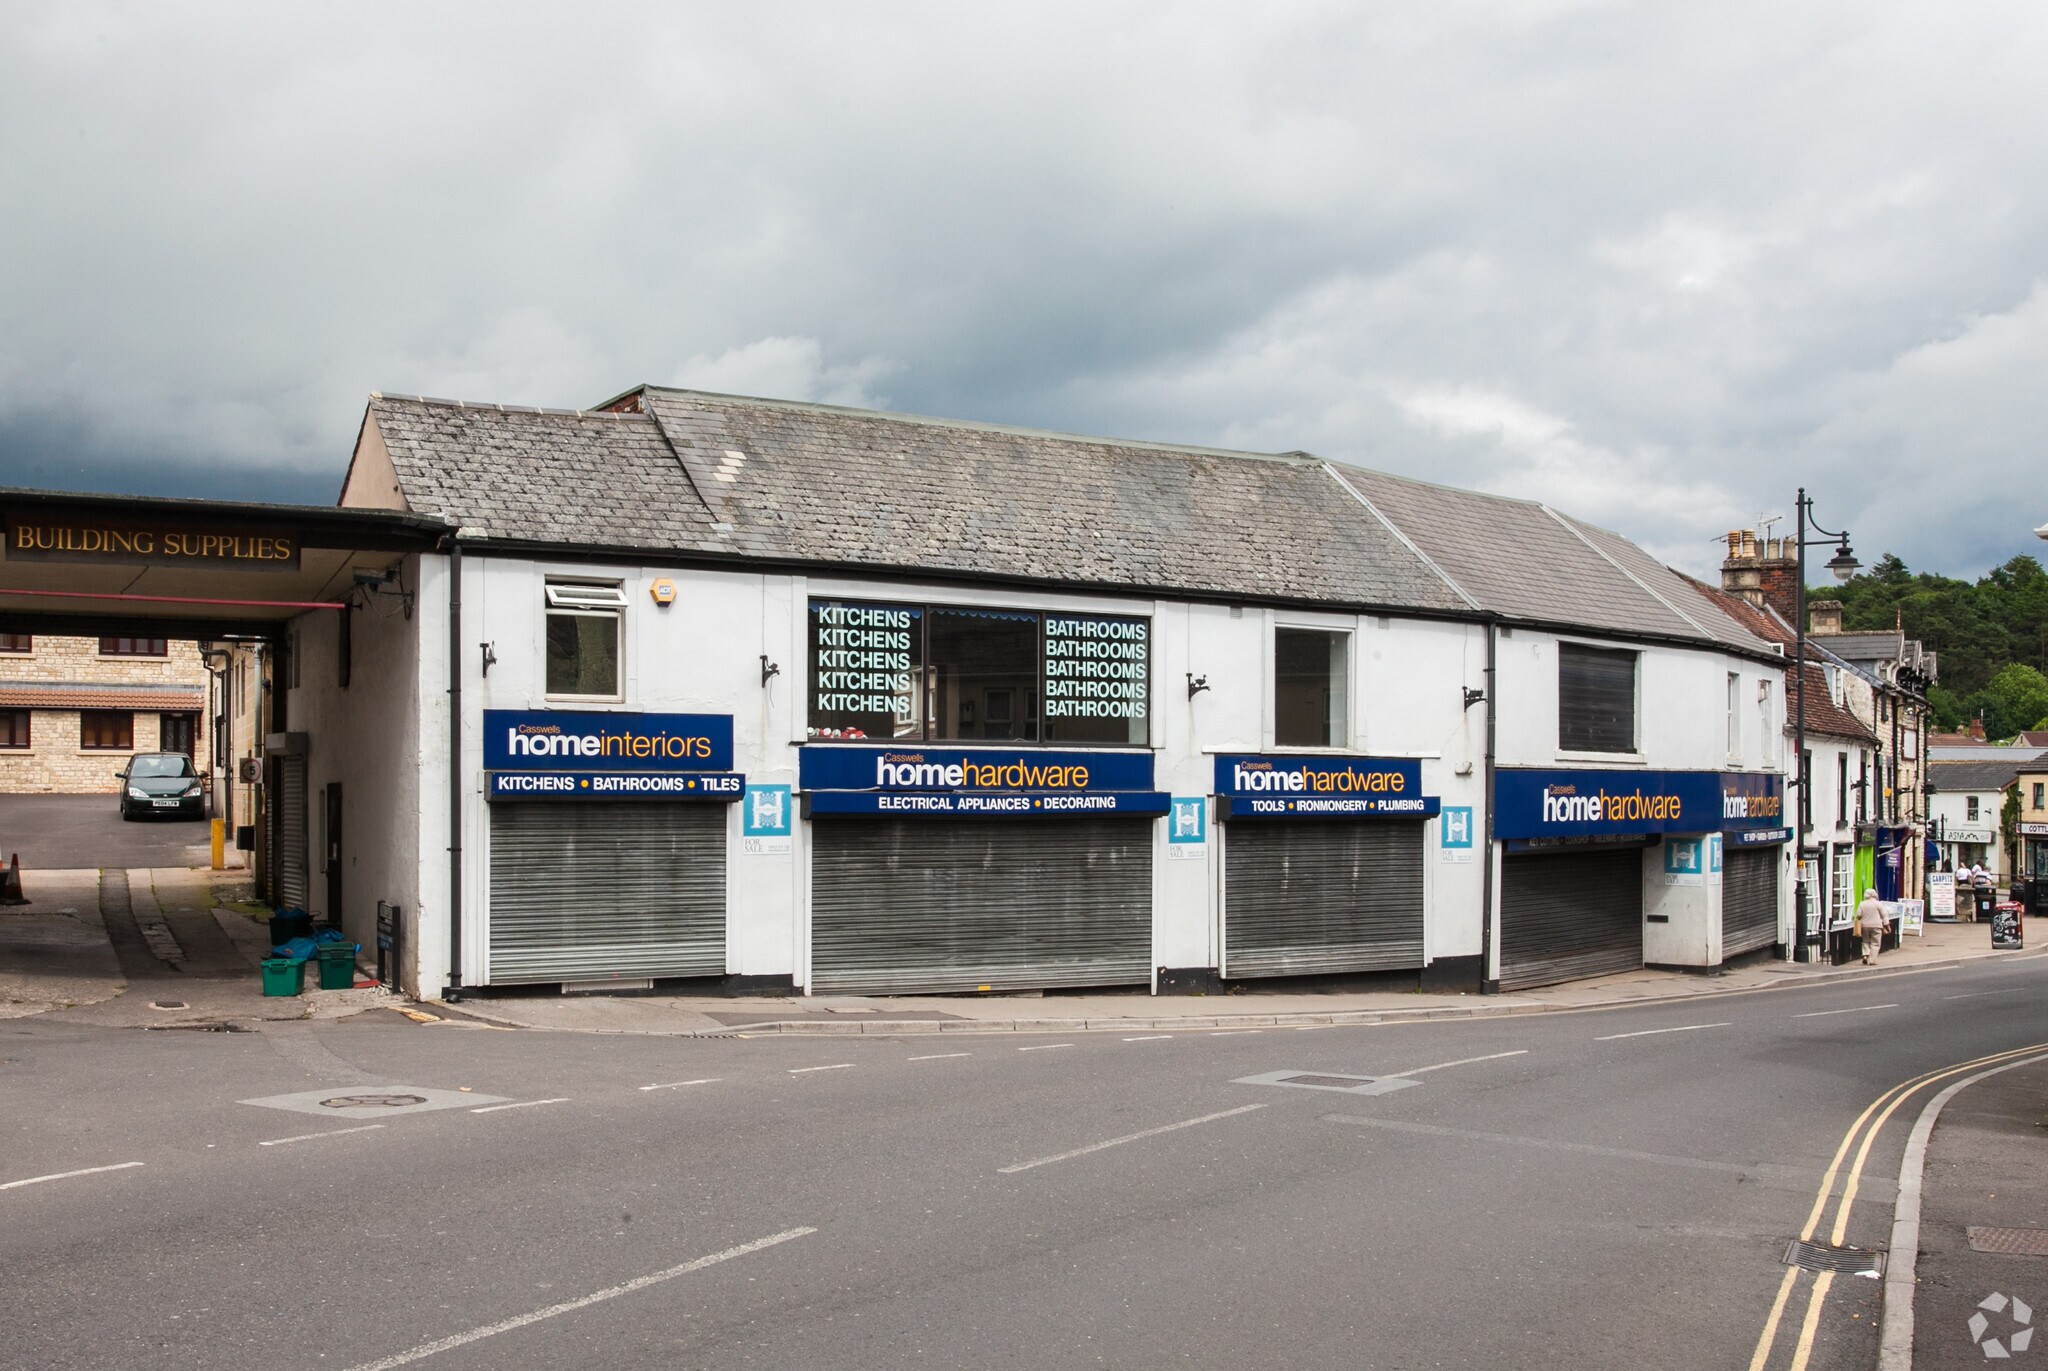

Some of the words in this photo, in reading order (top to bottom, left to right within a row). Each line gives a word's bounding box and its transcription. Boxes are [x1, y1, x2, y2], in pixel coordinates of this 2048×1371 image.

[17, 526, 154, 554] BUILDING
[164, 533, 291, 560] SUPPLIES
[818, 607, 911, 628] KITCHENS
[818, 628, 911, 650] KITCHENS
[1046, 619, 1147, 641] BATHROOMS
[1046, 640, 1147, 660] BATHROOMS
[818, 650, 911, 671] KITCHENS
[1046, 660, 1147, 680] BATHROOMS
[818, 671, 911, 692] KITCHENS
[1046, 680, 1147, 700] BATHROOMS
[818, 693, 911, 714] KITCHENS
[1046, 700, 1147, 719] BATHROOMS
[518, 724, 561, 735] Casswells
[884, 752, 925, 763] Casswells
[249, 766, 256, 776] 5
[498, 776, 575, 791] KITCHENS
[593, 777, 685, 792] BATHROOMS
[701, 777, 740, 792] TILES
[878, 796, 954, 810] ELECTRICAL
[958, 797, 1030, 811] APPLIANCES
[1043, 796, 1116, 810] DECORATING
[1251, 799, 1286, 812] TOOLS
[1296, 799, 1368, 812] IRONMONGERY
[1378, 799, 1424, 811] PLUMBING
[745, 838, 760, 846] FOR
[745, 845, 763, 853] SALE
